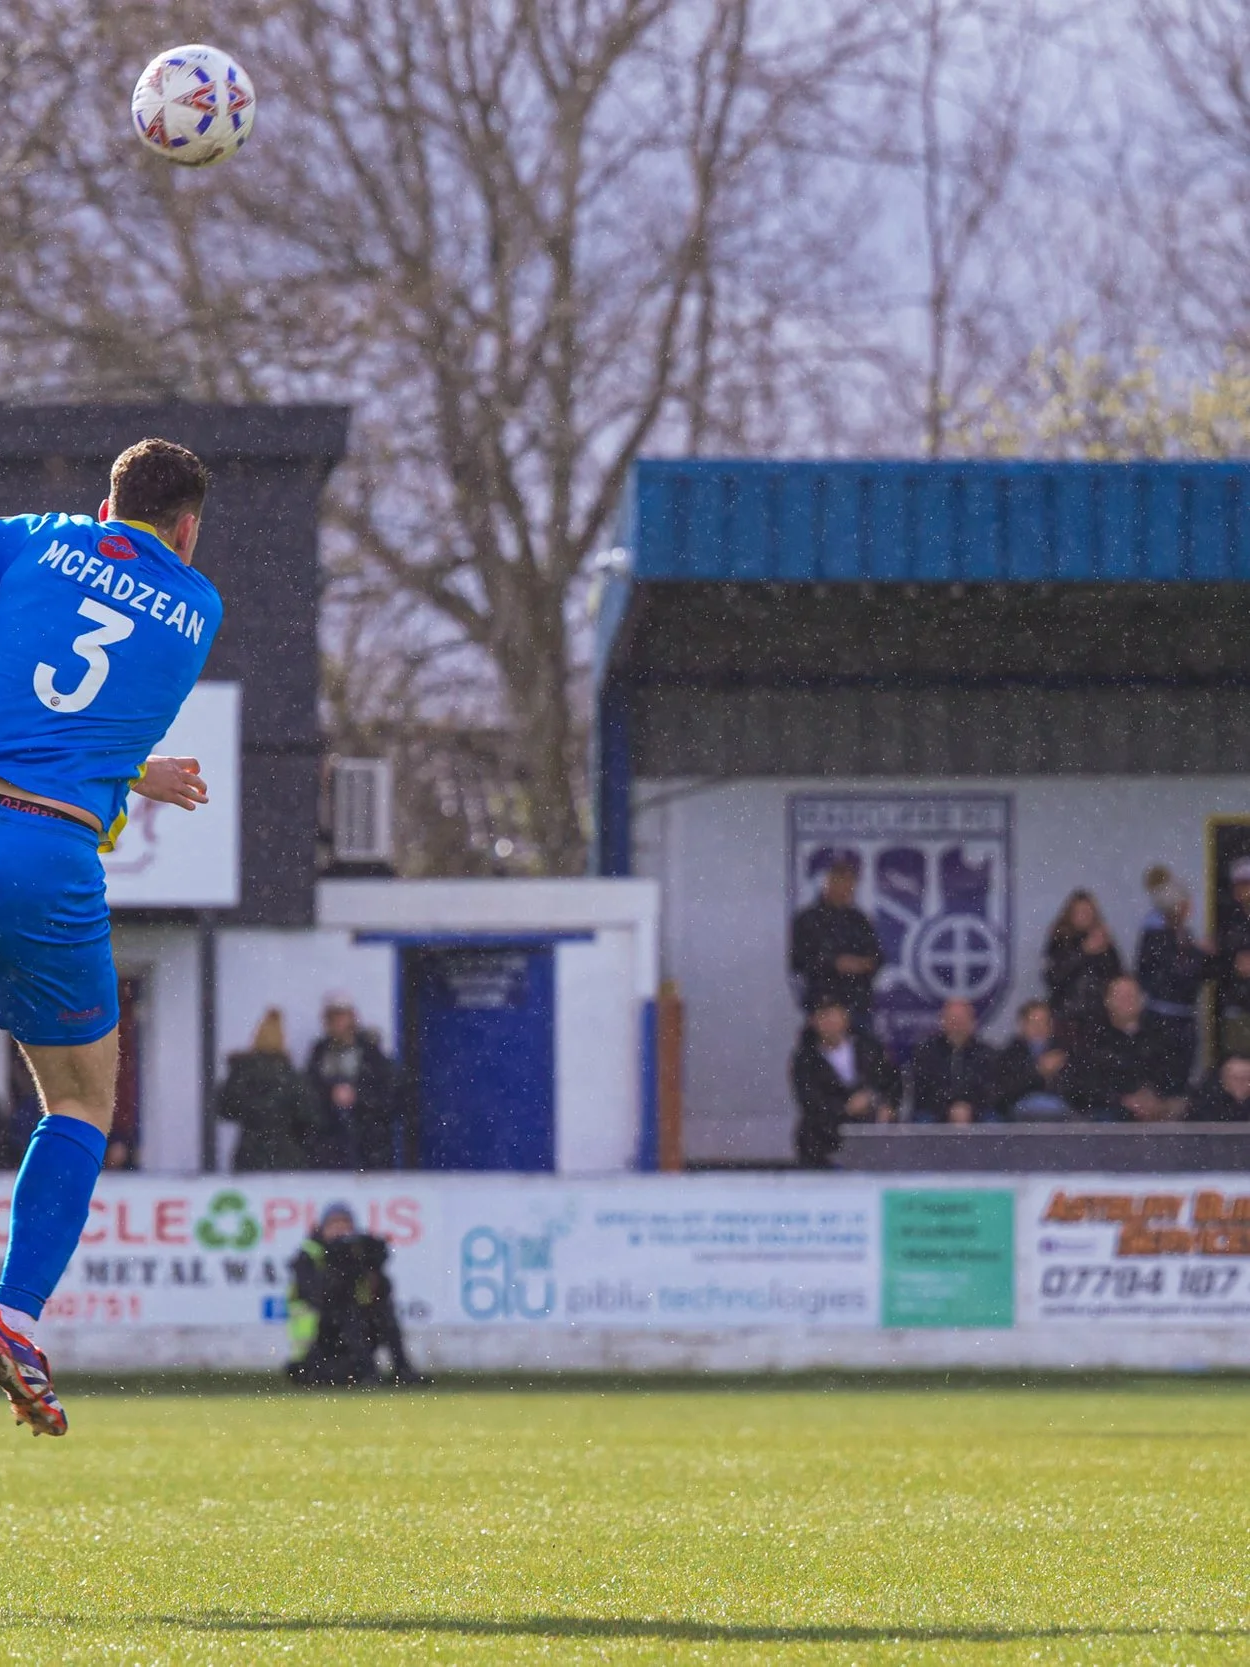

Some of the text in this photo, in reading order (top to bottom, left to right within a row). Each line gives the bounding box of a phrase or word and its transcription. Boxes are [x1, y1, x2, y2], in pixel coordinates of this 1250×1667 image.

[38, 541, 205, 645] MCFADZEAN
[32, 597, 136, 713] 3
[86, 1257, 207, 1285] METAL
[657, 1277, 869, 1323] technologies
